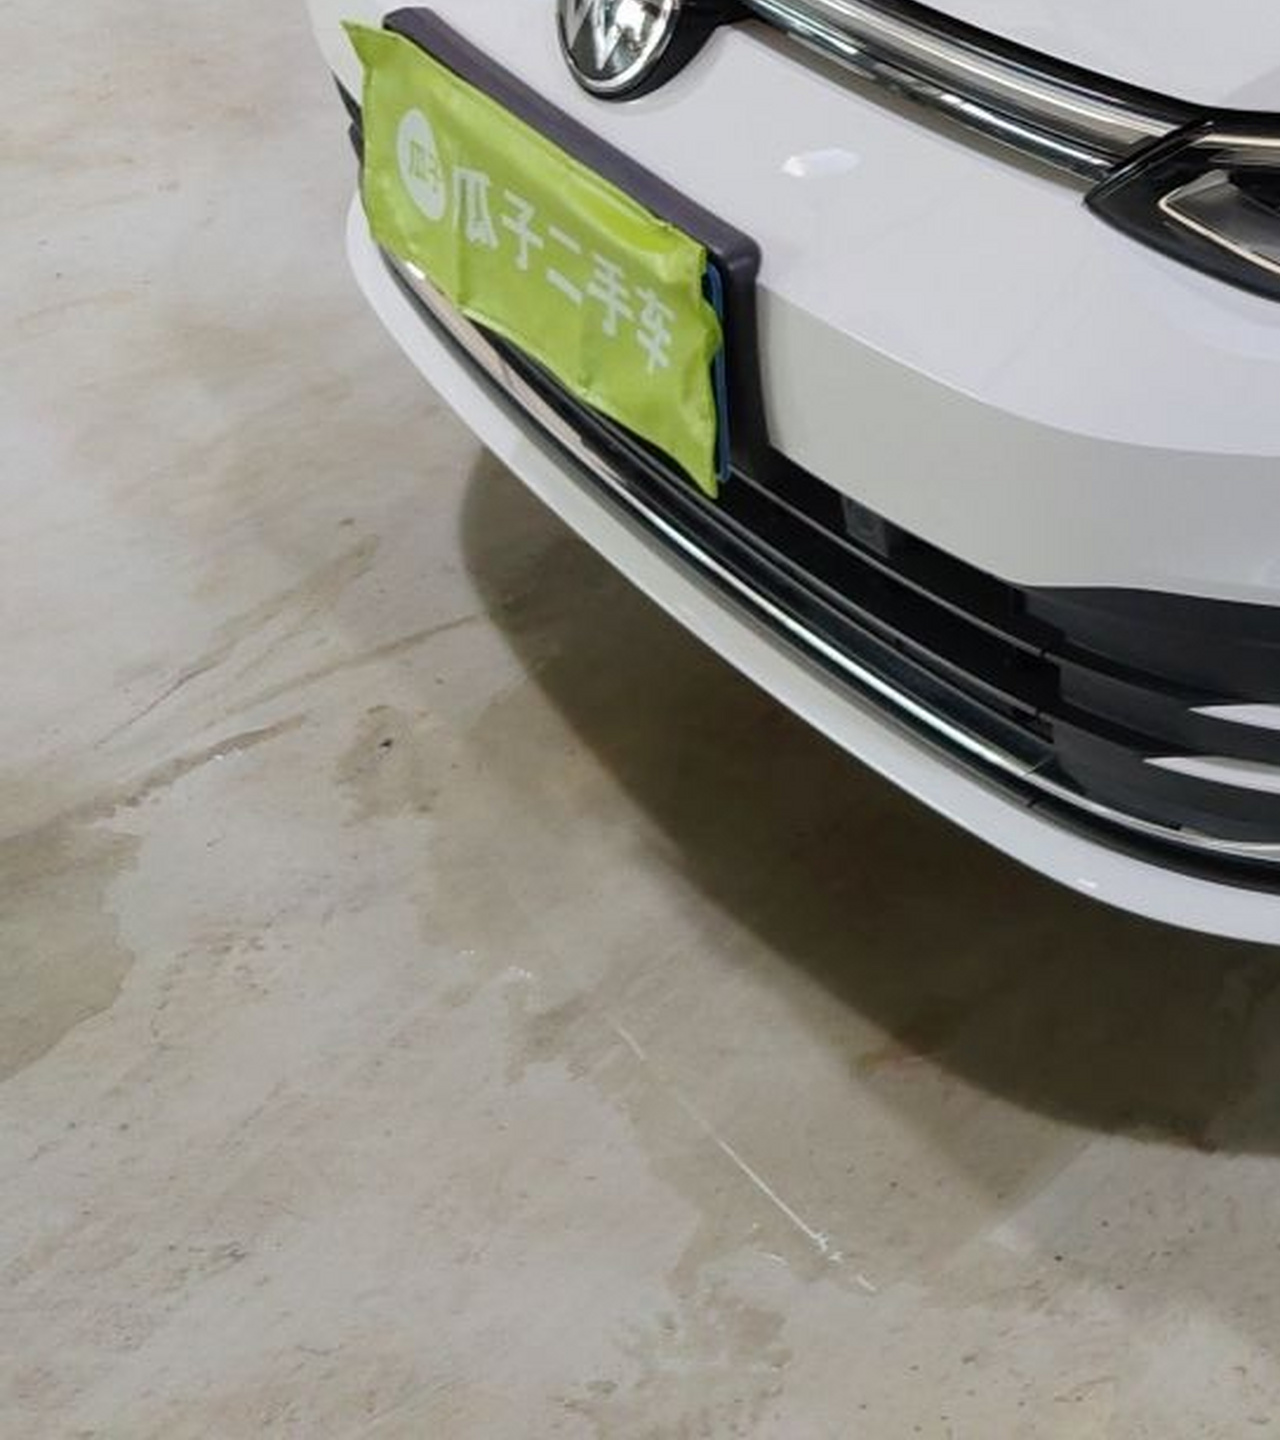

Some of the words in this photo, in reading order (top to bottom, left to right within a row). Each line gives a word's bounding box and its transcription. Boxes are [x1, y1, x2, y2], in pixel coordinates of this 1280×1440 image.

[452, 166, 677, 376] 瓜子二手车
